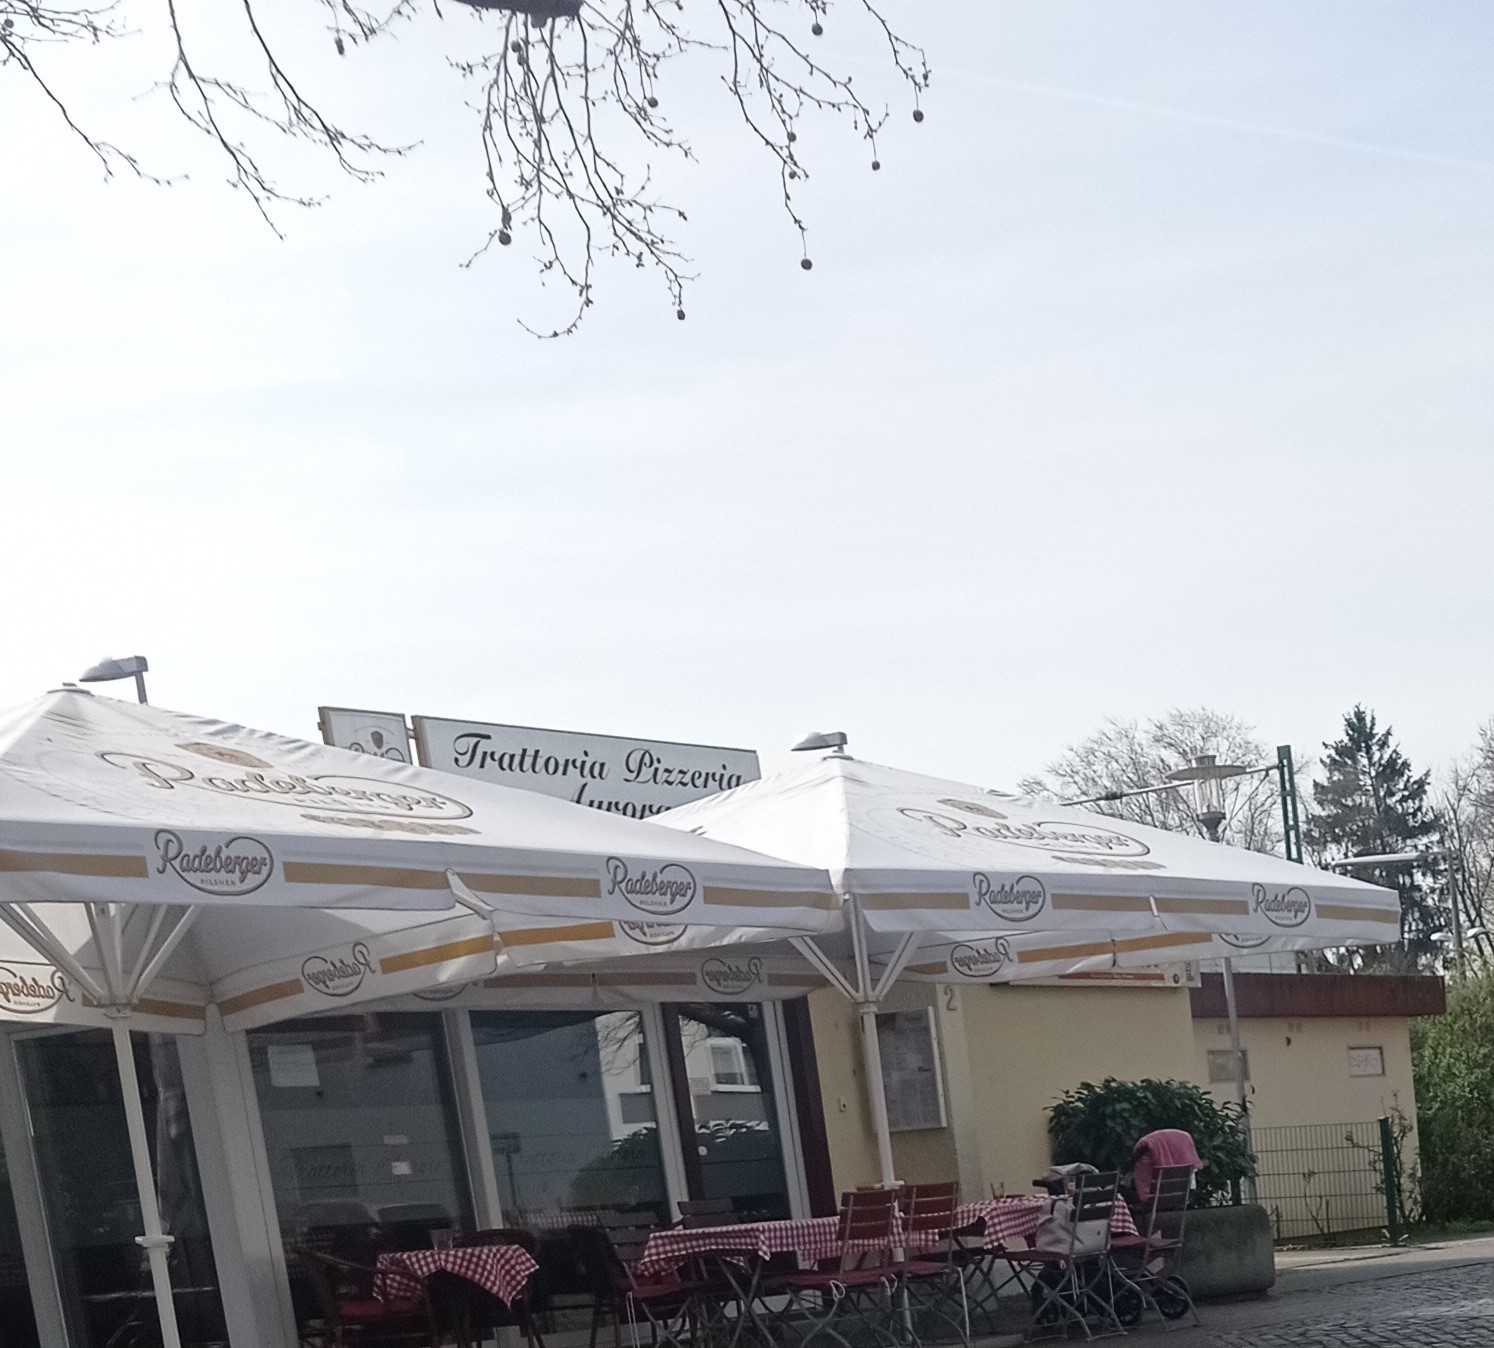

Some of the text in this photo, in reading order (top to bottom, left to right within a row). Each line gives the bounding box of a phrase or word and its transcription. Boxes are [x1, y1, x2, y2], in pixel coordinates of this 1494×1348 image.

[99, 752, 449, 811] Radeberger
[453, 732, 746, 790] Trattoria Pizzeria
[154, 829, 268, 884] Radeberger
[606, 856, 693, 905] Radeberger
[973, 872, 1042, 912] Radeberger
[944, 985, 958, 1011] 2
